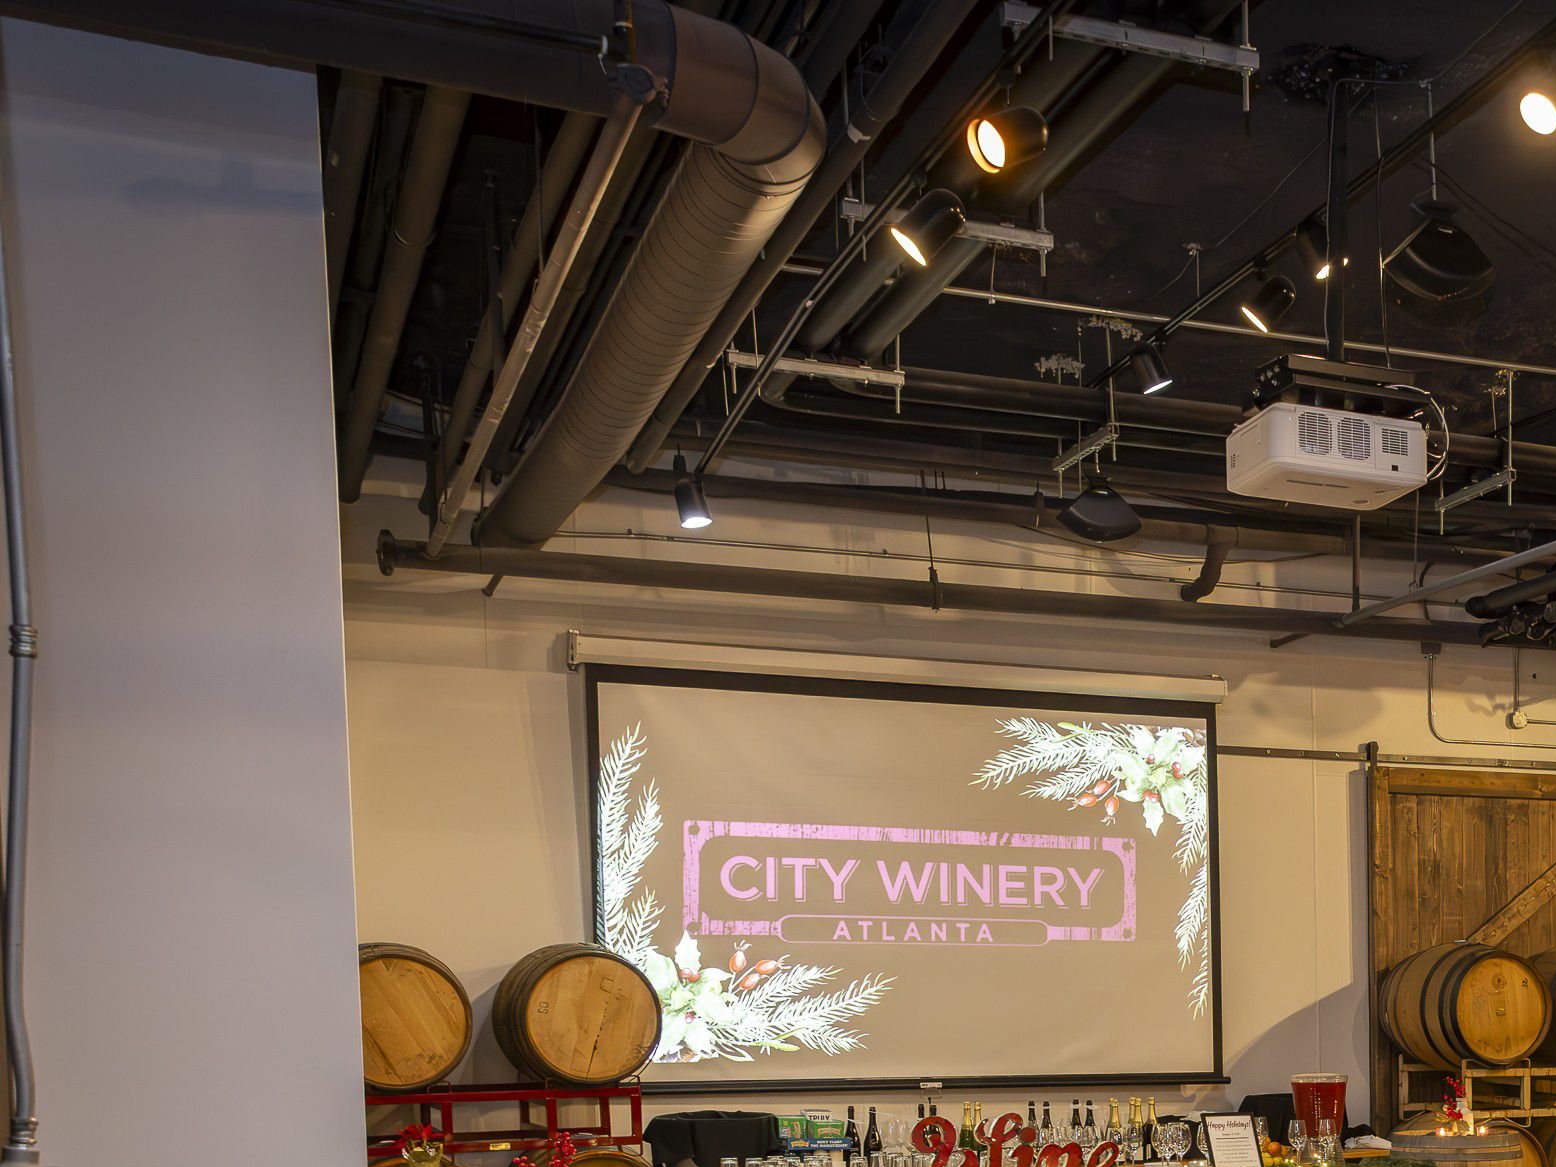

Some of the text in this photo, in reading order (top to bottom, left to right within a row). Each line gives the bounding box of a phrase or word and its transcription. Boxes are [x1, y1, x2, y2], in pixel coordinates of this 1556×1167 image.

[719, 855, 1105, 910] CITY WINERY
[832, 920, 994, 943] ATLANTA
[1207, 1121, 1226, 1131] Happy
